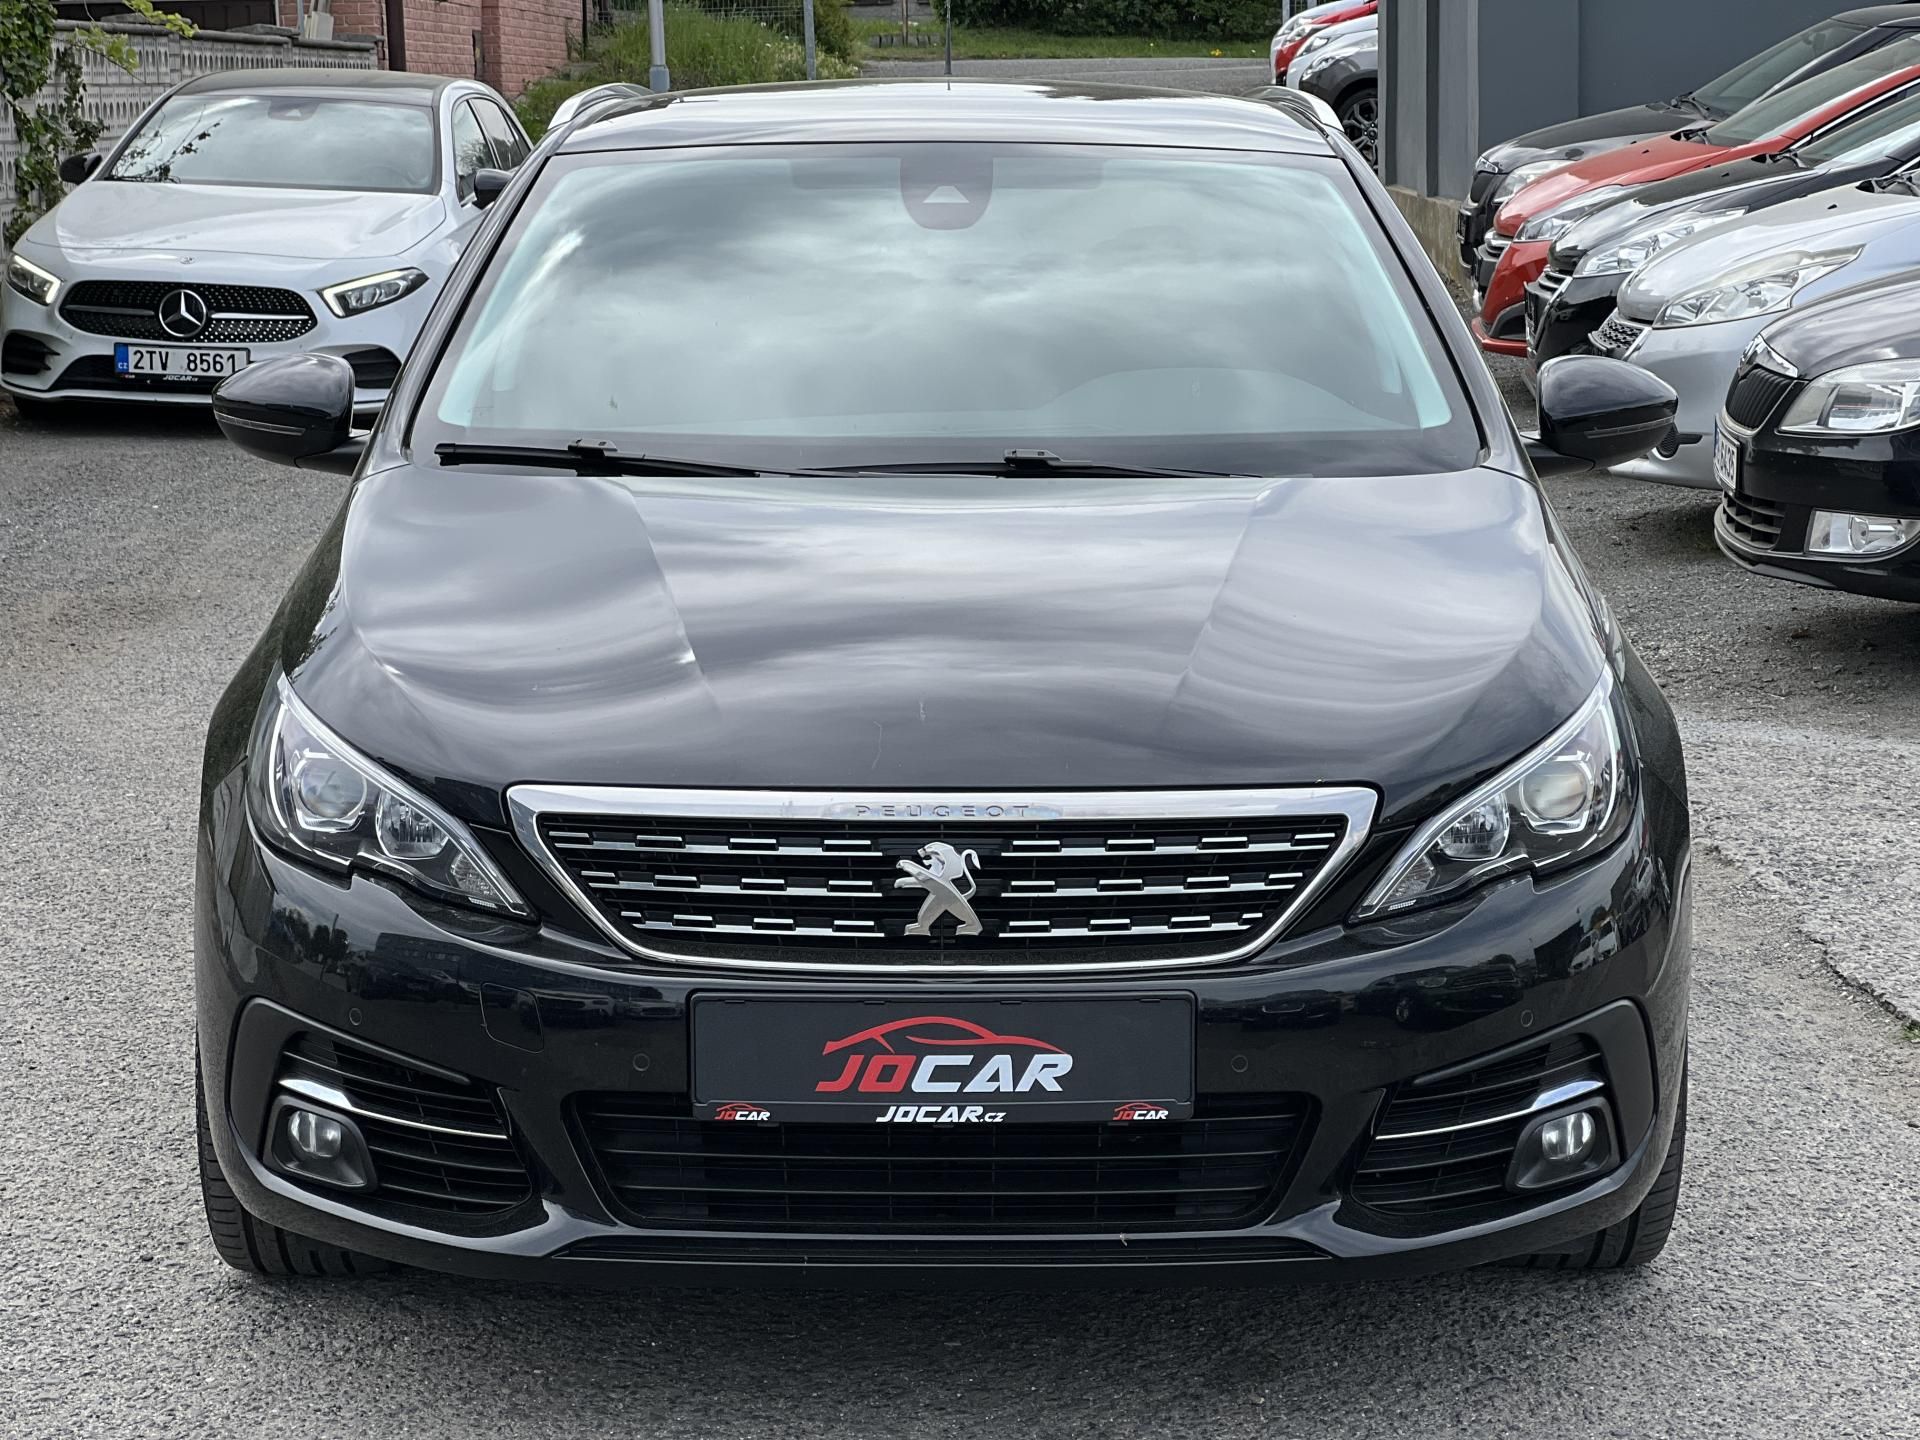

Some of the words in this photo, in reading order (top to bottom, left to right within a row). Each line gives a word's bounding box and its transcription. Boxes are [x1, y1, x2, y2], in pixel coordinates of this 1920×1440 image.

[133, 350, 169, 371] 2TV
[186, 352, 236, 373] 8561
[855, 805, 1029, 817] PEUGEOT
[815, 1053, 1073, 1092] JOCAR
[714, 1109, 771, 1121] JOCAR
[1112, 1109, 1169, 1121] JOCAR
